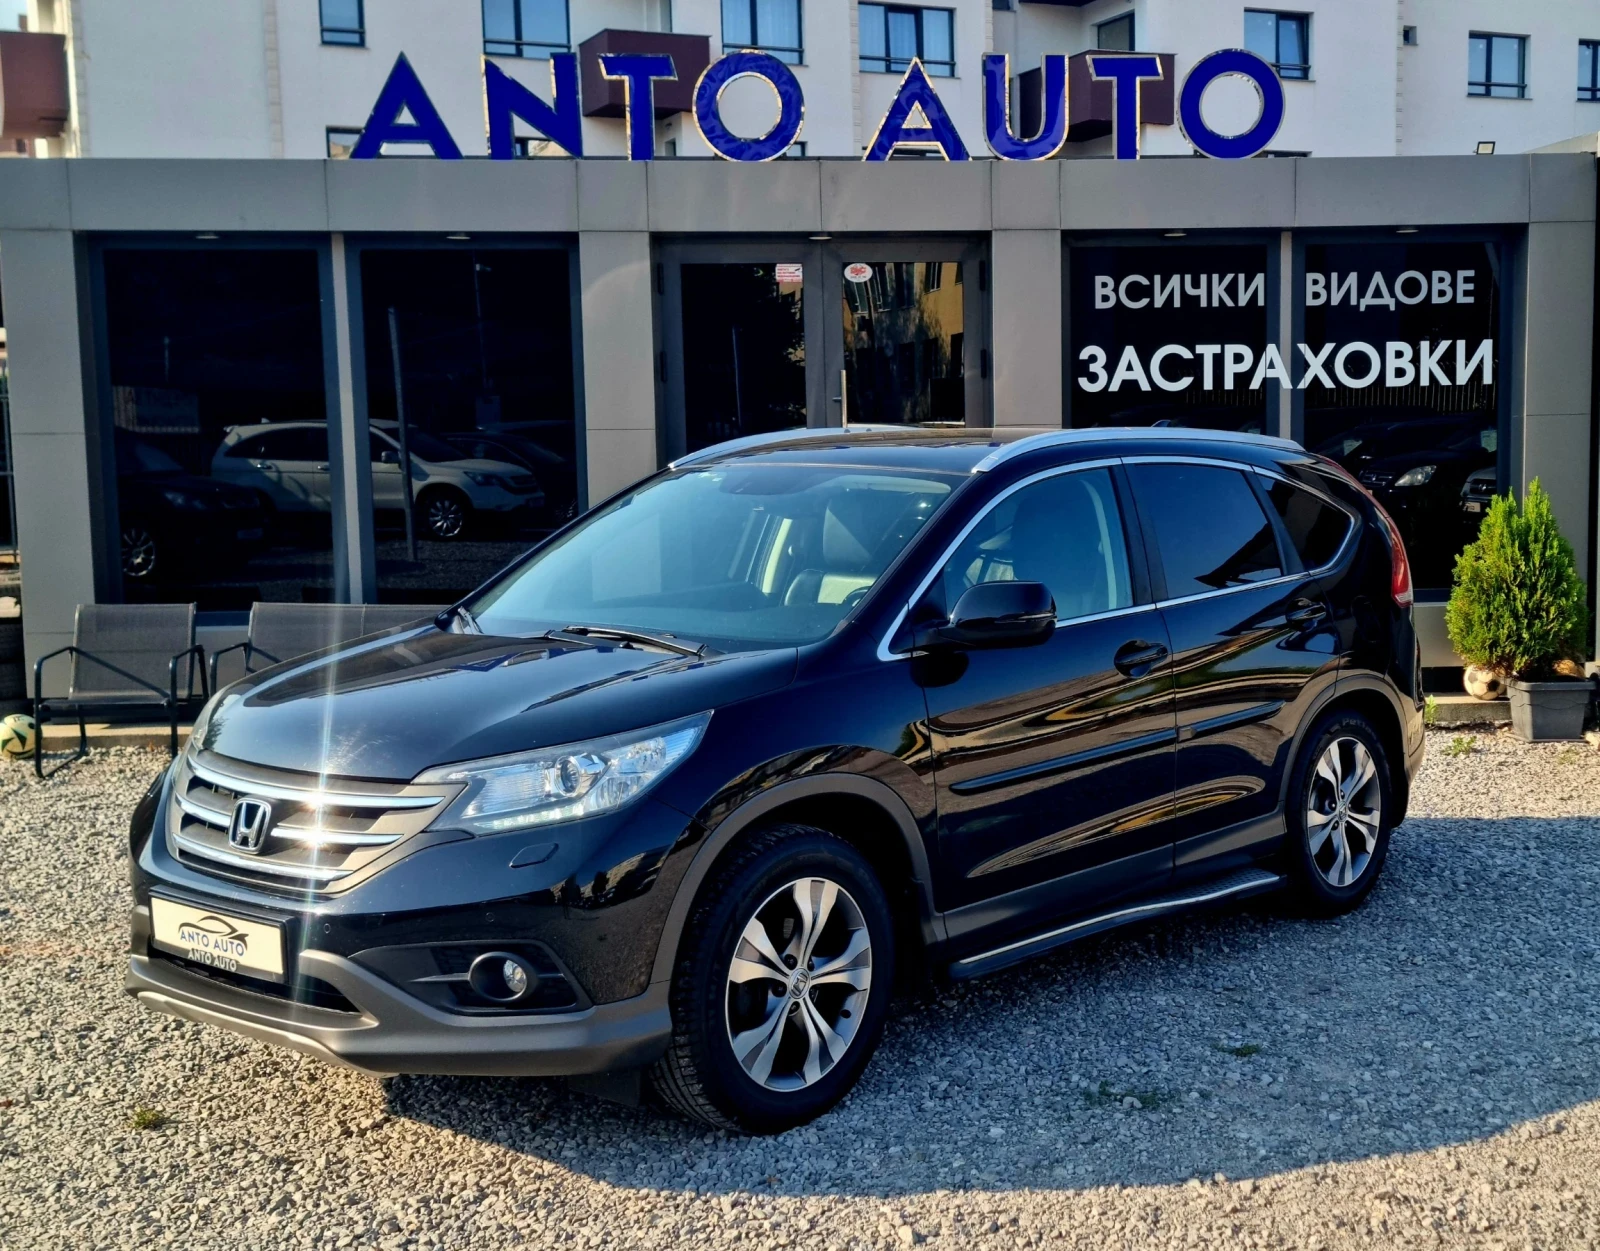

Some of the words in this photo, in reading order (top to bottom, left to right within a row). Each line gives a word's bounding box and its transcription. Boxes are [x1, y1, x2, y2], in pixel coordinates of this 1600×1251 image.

[349, 48, 806, 162] ANTO
[861, 48, 1286, 162] AUTO
[1094, 273, 1265, 309] ВСИЧКИ
[1305, 269, 1476, 312] ВИДОВЕ
[1077, 338, 1494, 393] ЗАСТРАХОВКИ
[180, 931, 210, 948] ANTO
[213, 939, 245, 957] AUTO
[187, 948, 212, 965] ANTO
[213, 956, 237, 972] AUTO
